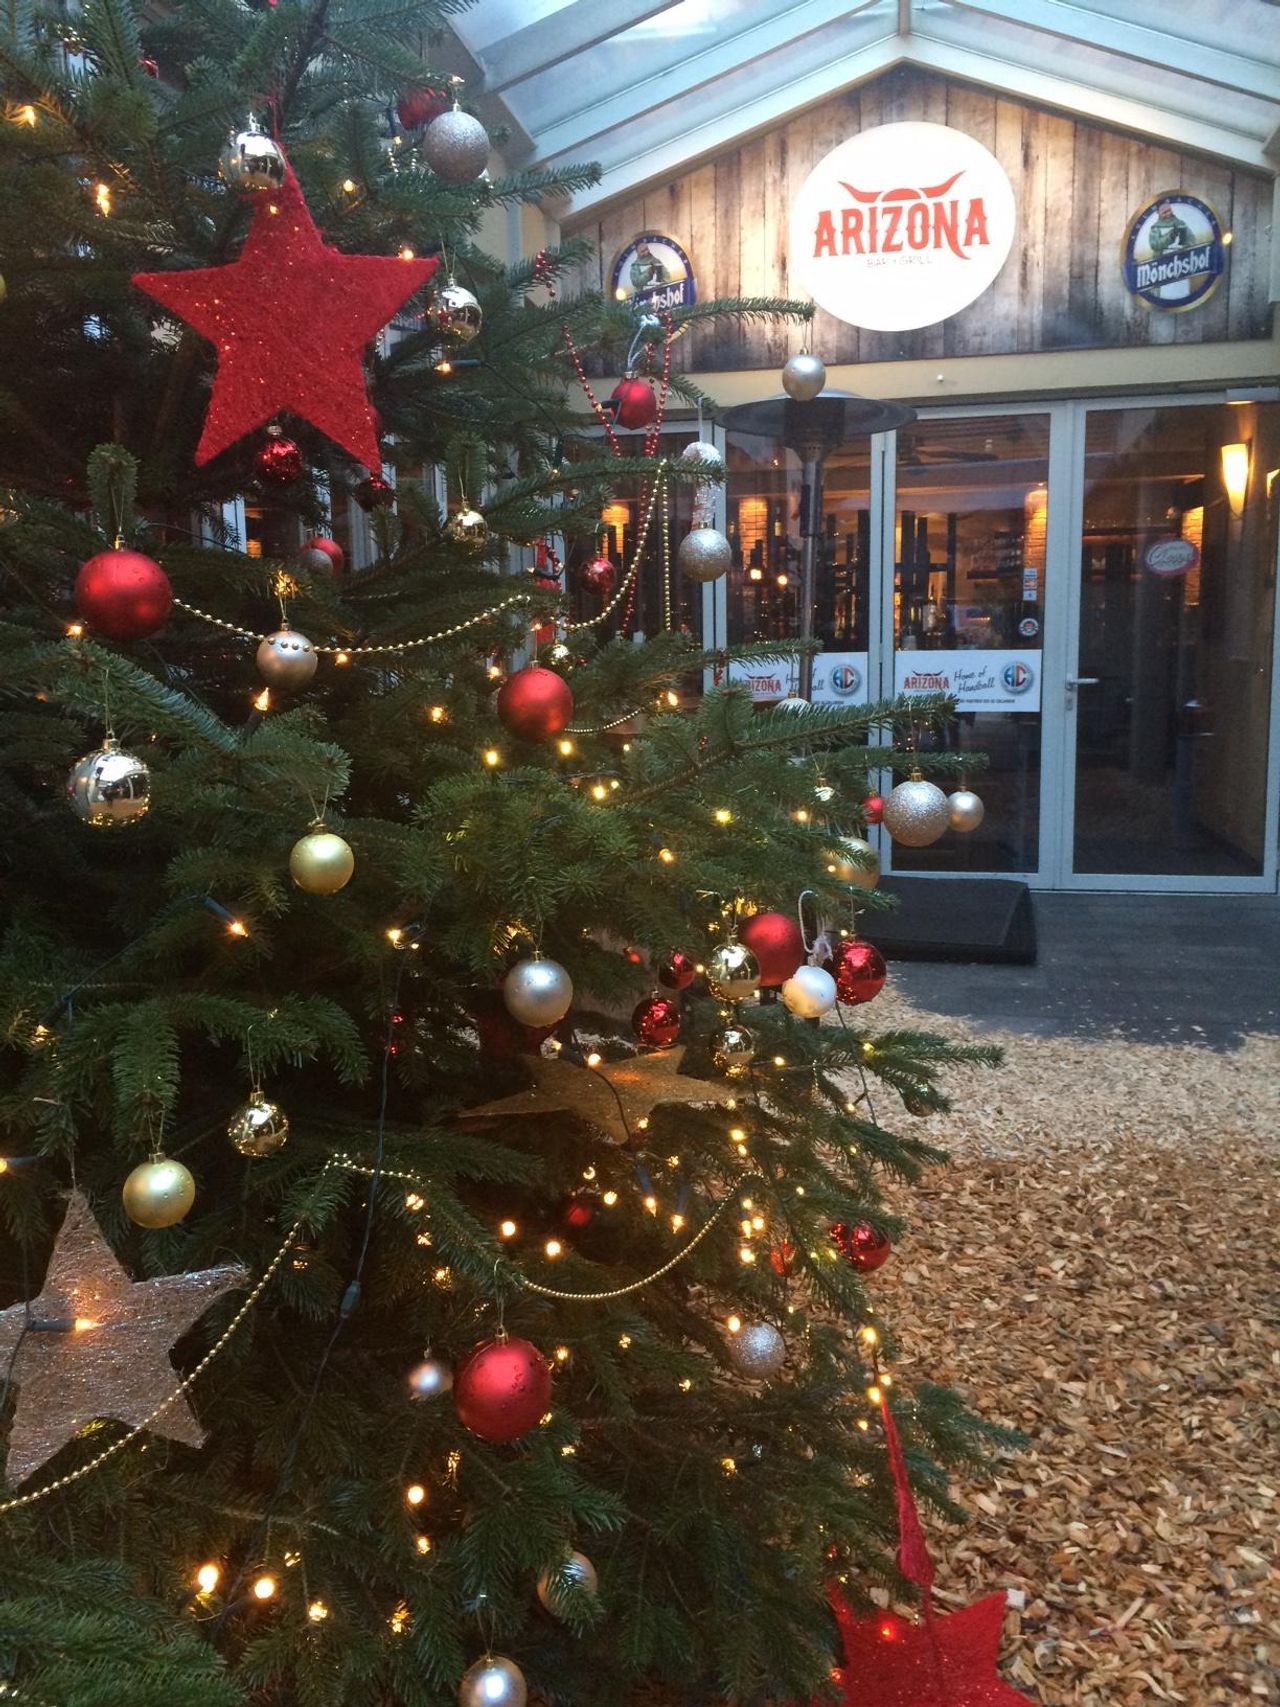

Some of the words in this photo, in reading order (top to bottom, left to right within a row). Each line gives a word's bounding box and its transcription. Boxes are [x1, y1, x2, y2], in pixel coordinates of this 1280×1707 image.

[813, 198, 990, 260] ARIZONA
[1136, 246, 1211, 288] Mönchshof
[953, 669, 976, 682] Home
[977, 665, 988, 678] of
[745, 679, 782, 695] RIZONA
[903, 676, 950, 691] ARIZONA
[957, 676, 996, 693] Handball
